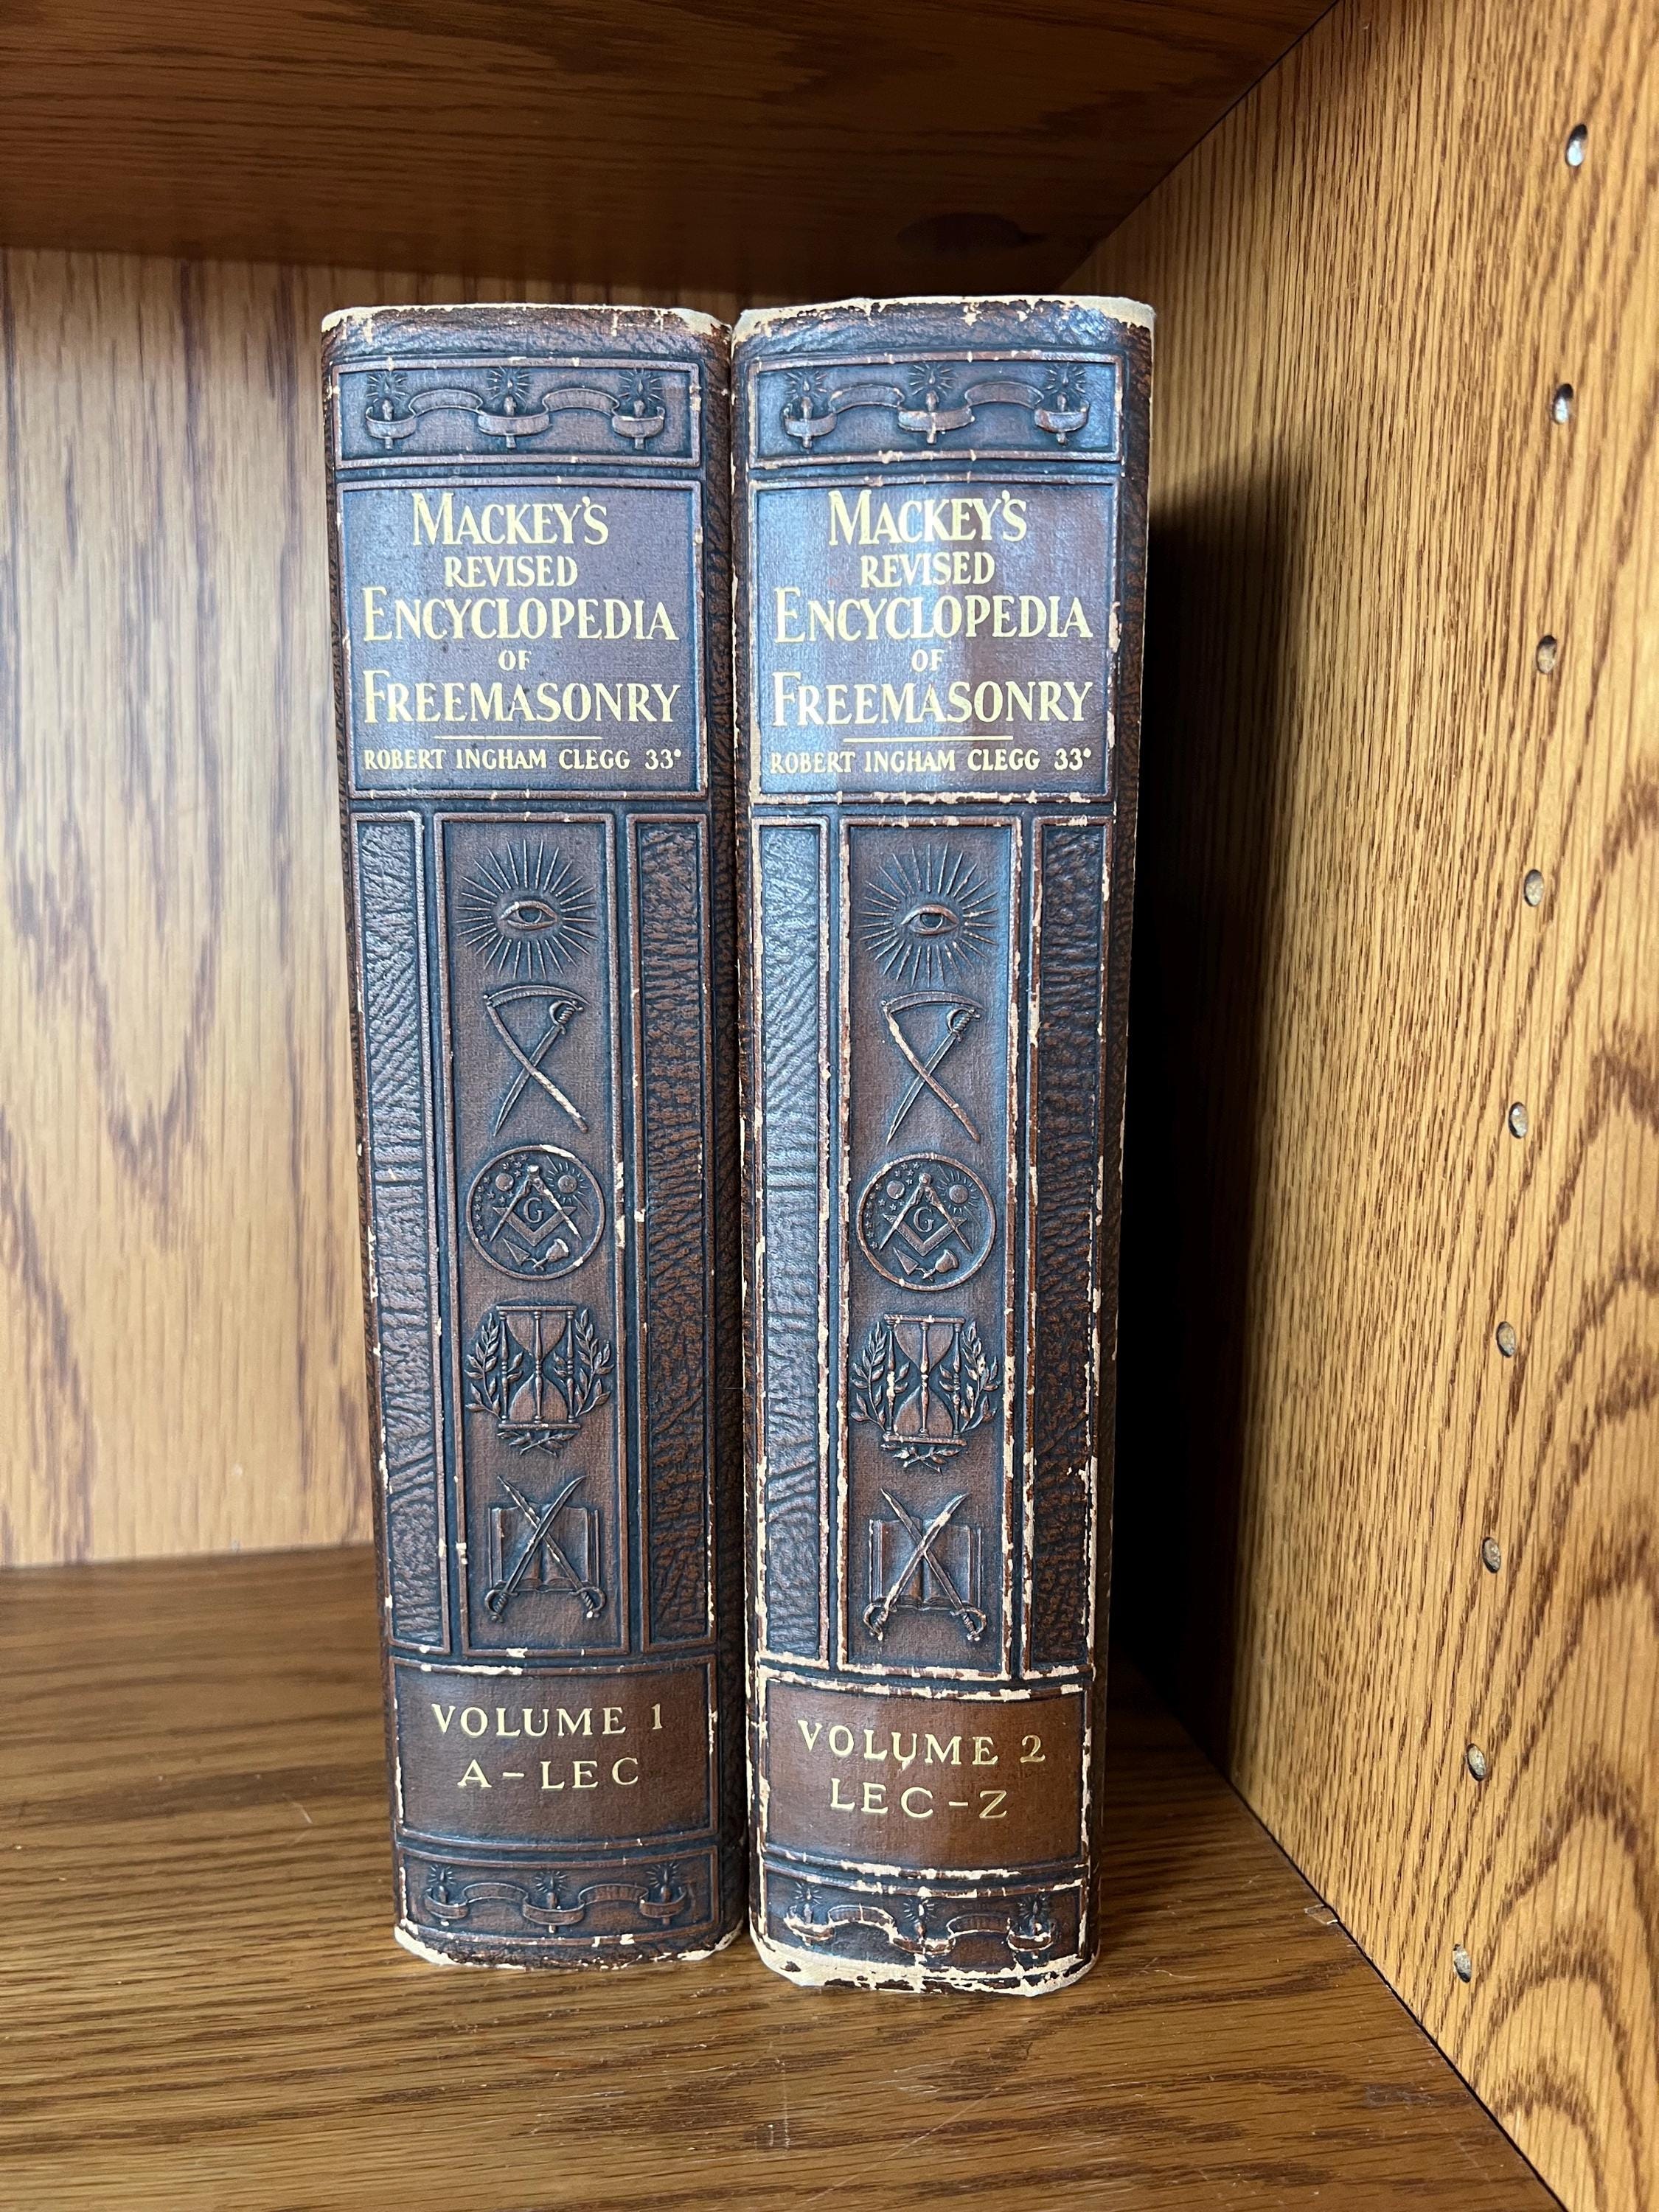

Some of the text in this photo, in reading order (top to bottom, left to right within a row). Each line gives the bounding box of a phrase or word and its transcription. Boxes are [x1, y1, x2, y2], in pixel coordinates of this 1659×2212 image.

[411, 492, 609, 546] MACKEY'S
[828, 490, 1027, 546] MACKEY'S
[445, 556, 578, 588] REVISED
[860, 552, 995, 588] REVISED
[362, 587, 679, 641] ENCYCLOPEDIA
[773, 587, 1093, 643] ENCYCLOPEDIA
[498, 650, 532, 671] OF
[911, 649, 945, 672] OF
[363, 670, 681, 724] FREEMASONRY
[772, 672, 1093, 727] FREEMASONRY
[364, 749, 446, 771] ROBERT
[456, 749, 547, 771] INGHAM
[558, 749, 630, 770] CLEGG
[770, 751, 855, 774] ROBERT
[865, 750, 956, 773] INGHAM
[967, 748, 1040, 771] CLEGG
[524, 1197, 544, 1223] G
[914, 1207, 935, 1233] G
[431, 1703, 664, 1738] VOLUME 1
[797, 1719, 1046, 1766] VOLUME 2
